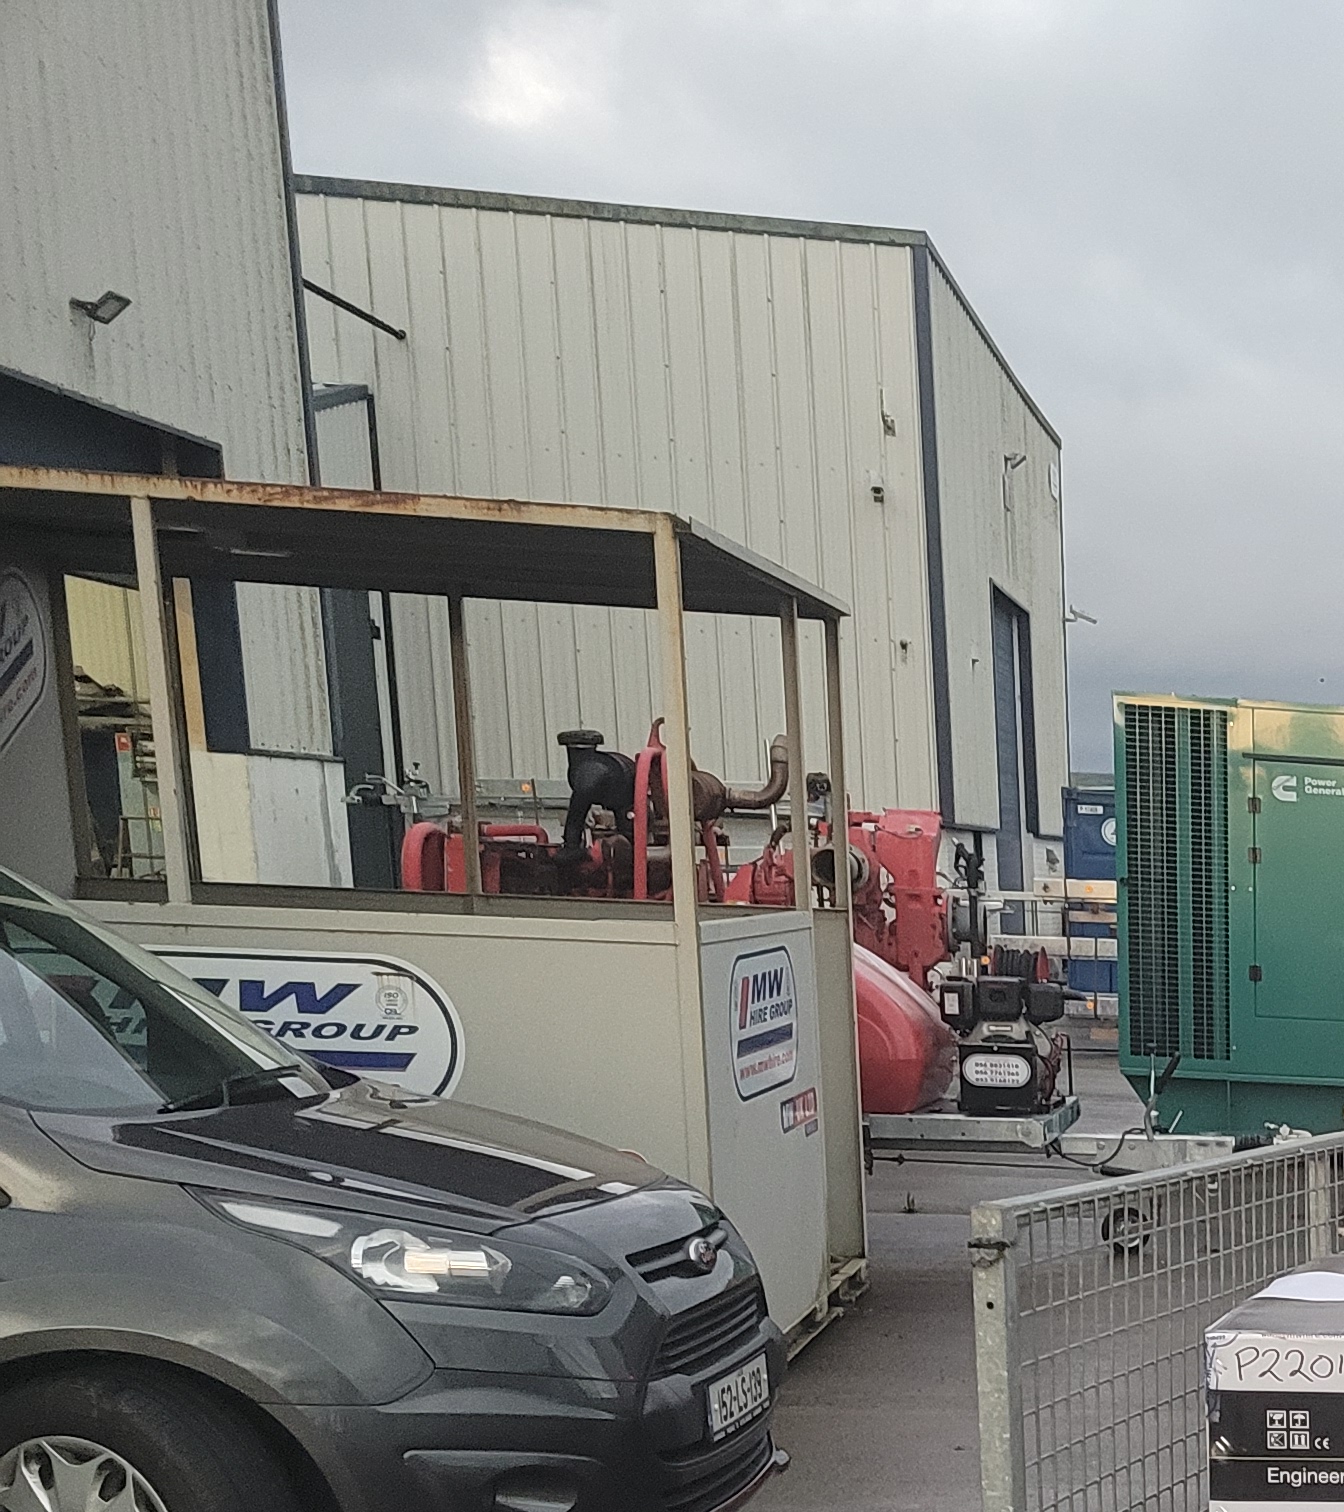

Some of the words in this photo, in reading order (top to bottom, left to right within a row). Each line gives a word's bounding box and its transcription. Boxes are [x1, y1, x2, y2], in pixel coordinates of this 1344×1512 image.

[1303, 777, 1338, 788] Power
[751, 966, 784, 1005] MW
[769, 999, 793, 1021] GROUP
